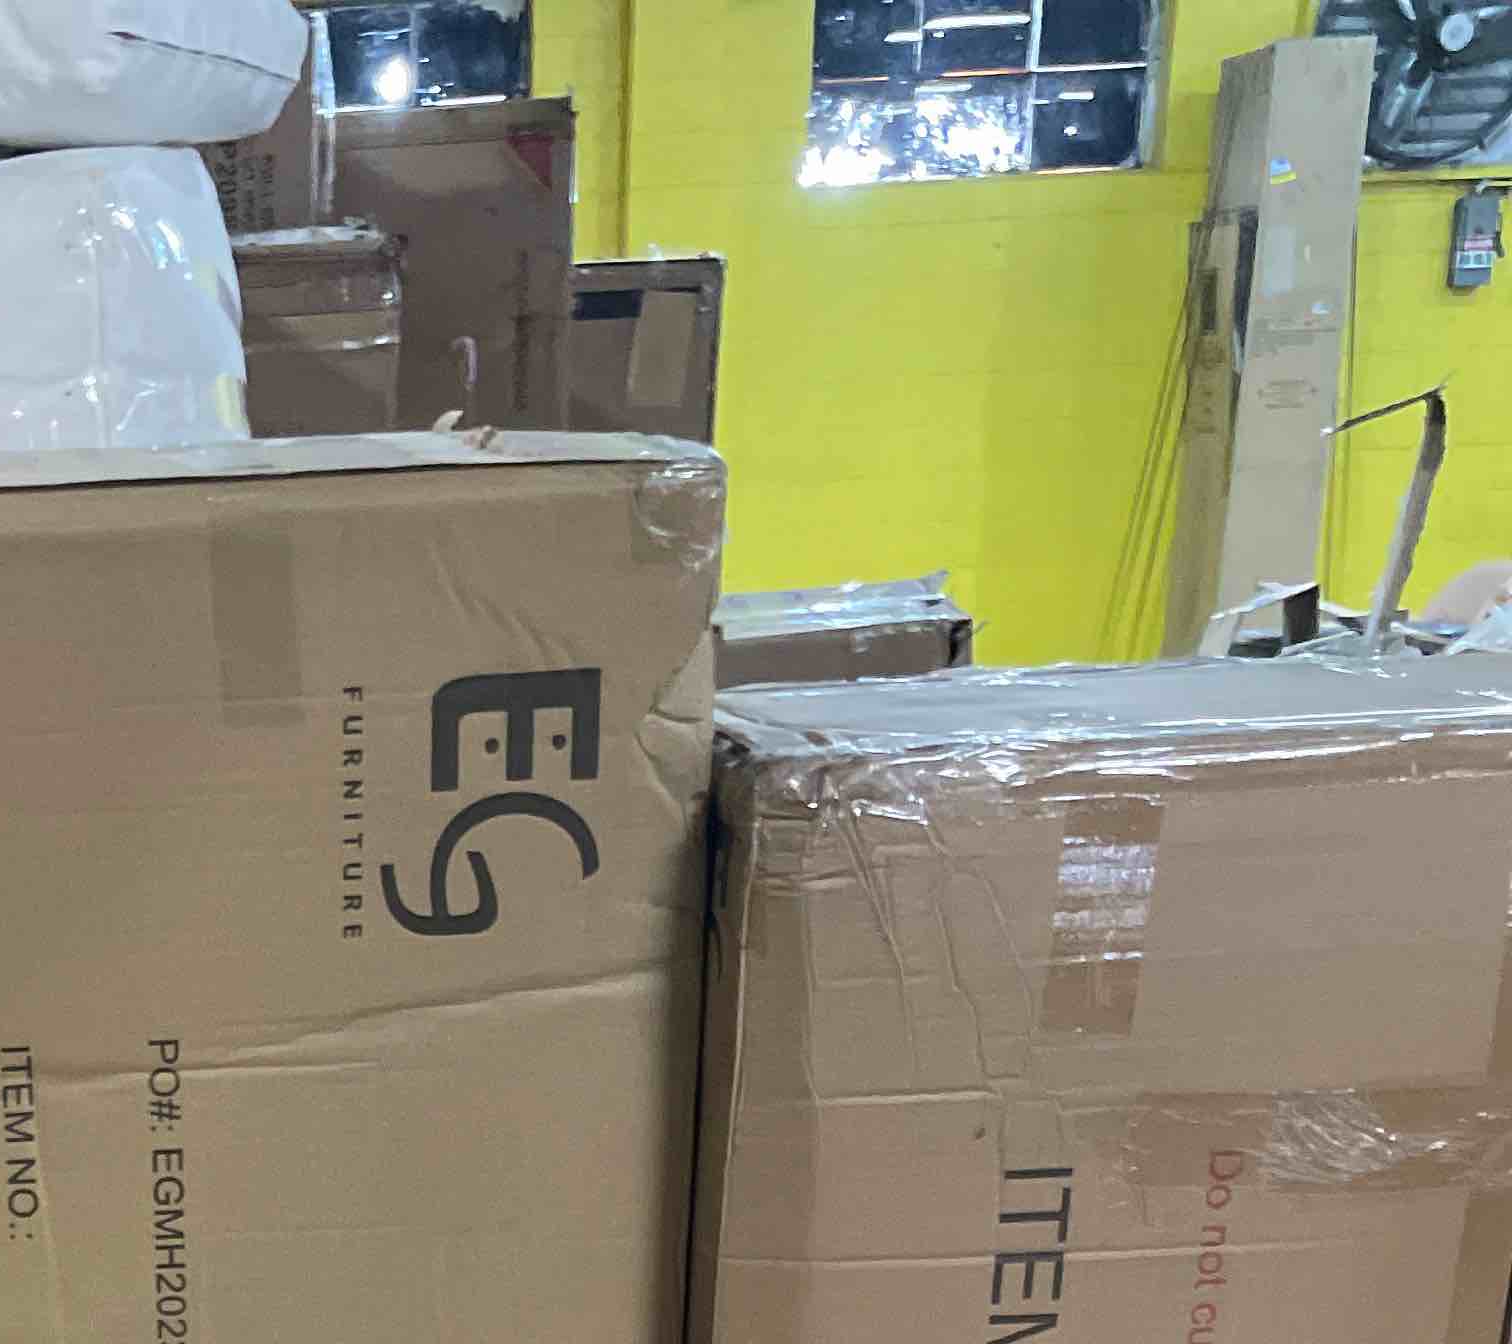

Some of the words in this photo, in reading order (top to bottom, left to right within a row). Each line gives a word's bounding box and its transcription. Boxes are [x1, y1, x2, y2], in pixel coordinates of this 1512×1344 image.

[342, 685, 364, 939] FURNITURE
[0, 1045, 36, 1144] ITEM
[147, 1038, 183, 1133] PO#:
[5, 1158, 40, 1240] NO.:
[1206, 1149, 1244, 1211] Do
[1194, 1224, 1228, 1289] not
